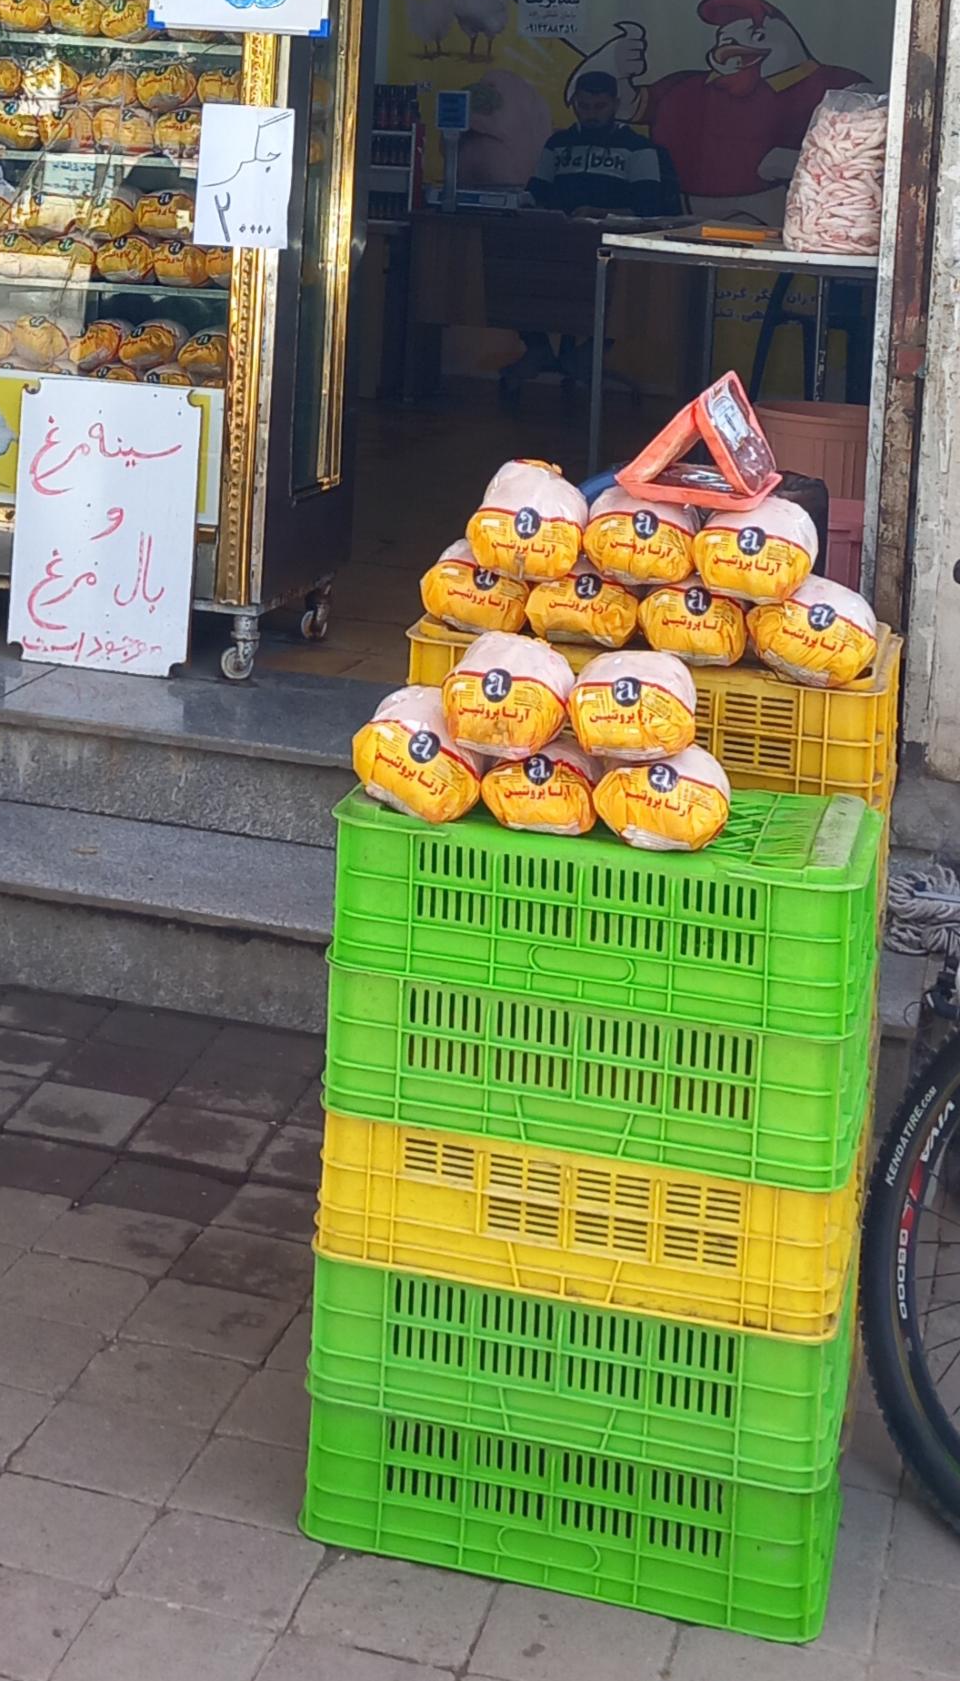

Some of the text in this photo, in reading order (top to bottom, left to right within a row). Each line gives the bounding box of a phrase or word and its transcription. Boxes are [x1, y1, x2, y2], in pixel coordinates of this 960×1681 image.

[202, 111, 292, 187] جگر
[29, 414, 183, 496] سینه مرغ
[89, 506, 125, 541] و
[27, 530, 165, 631] بال مرغ
